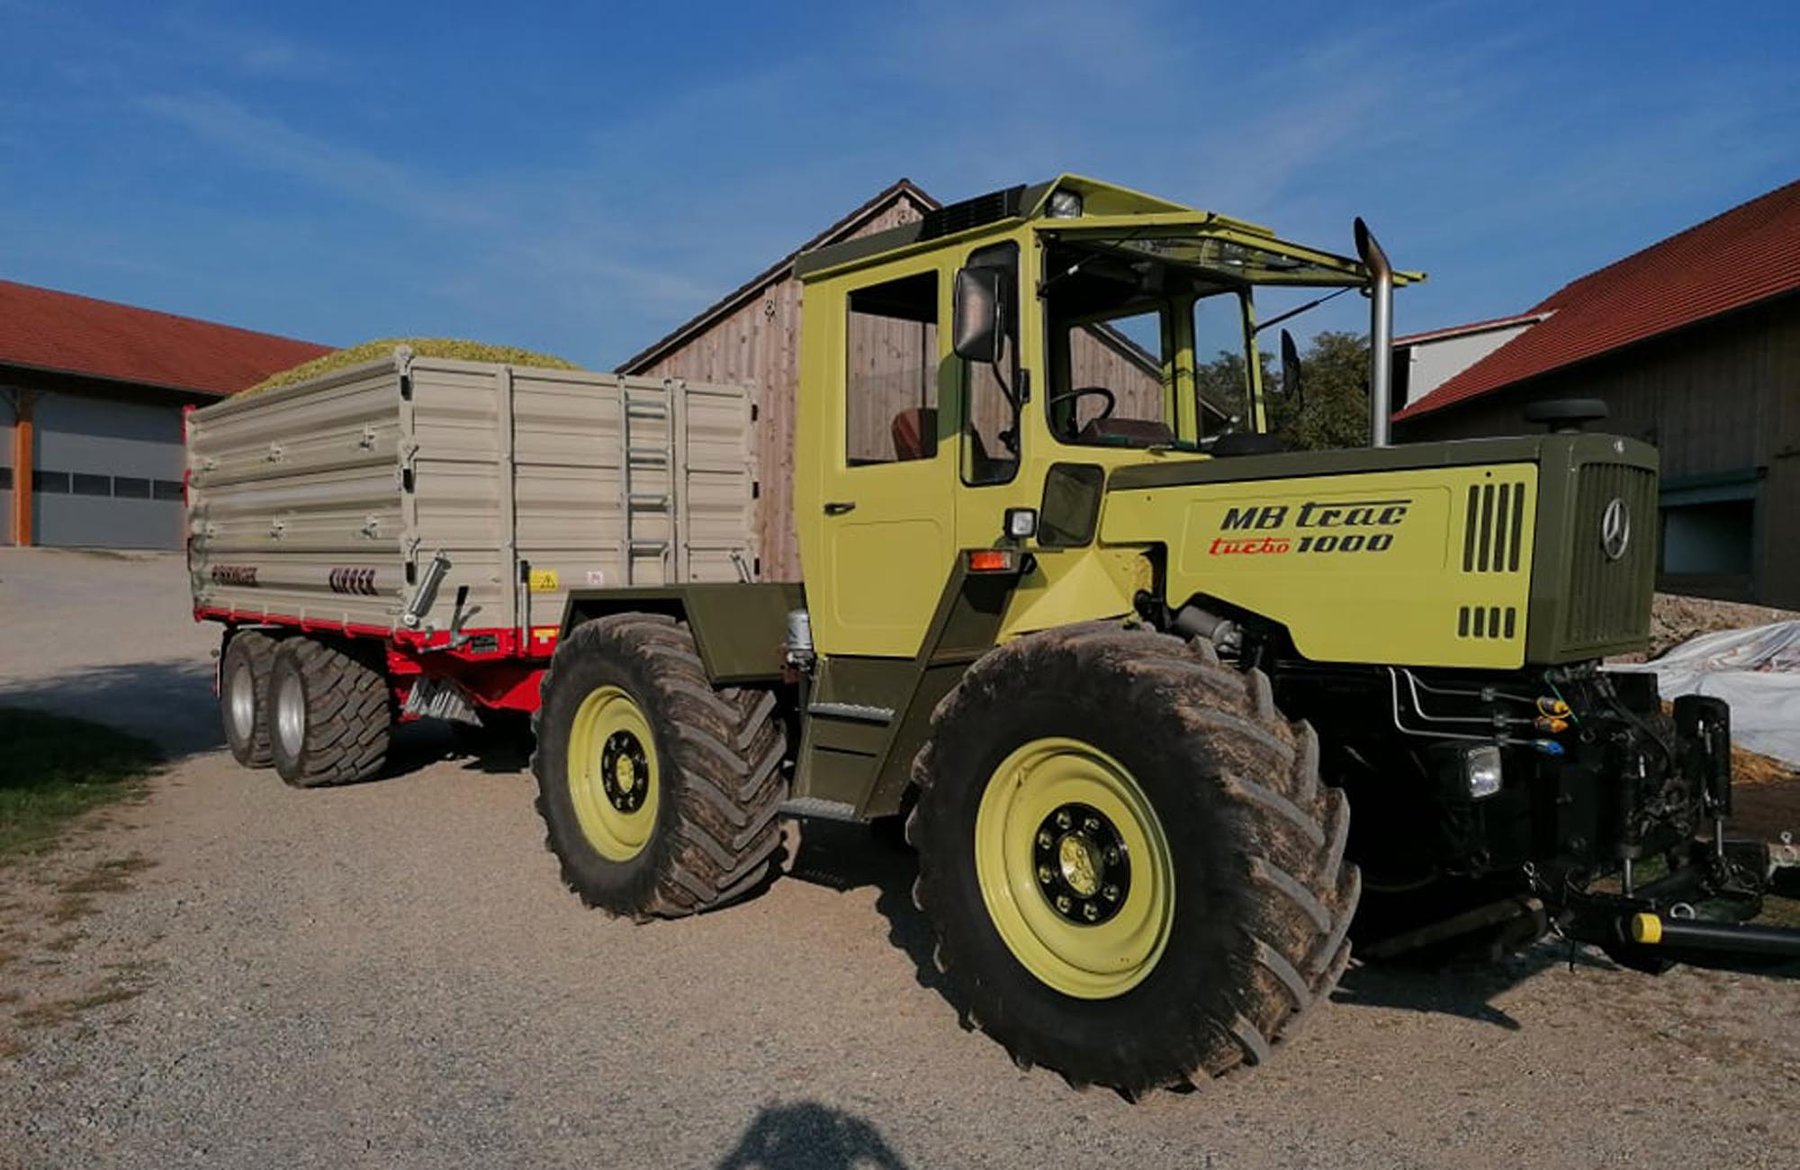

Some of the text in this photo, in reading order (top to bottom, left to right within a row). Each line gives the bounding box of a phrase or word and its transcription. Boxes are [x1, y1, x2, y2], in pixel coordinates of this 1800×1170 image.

[1219, 499, 1413, 531] MB trac
[1208, 533, 1394, 556] turbo 1000
